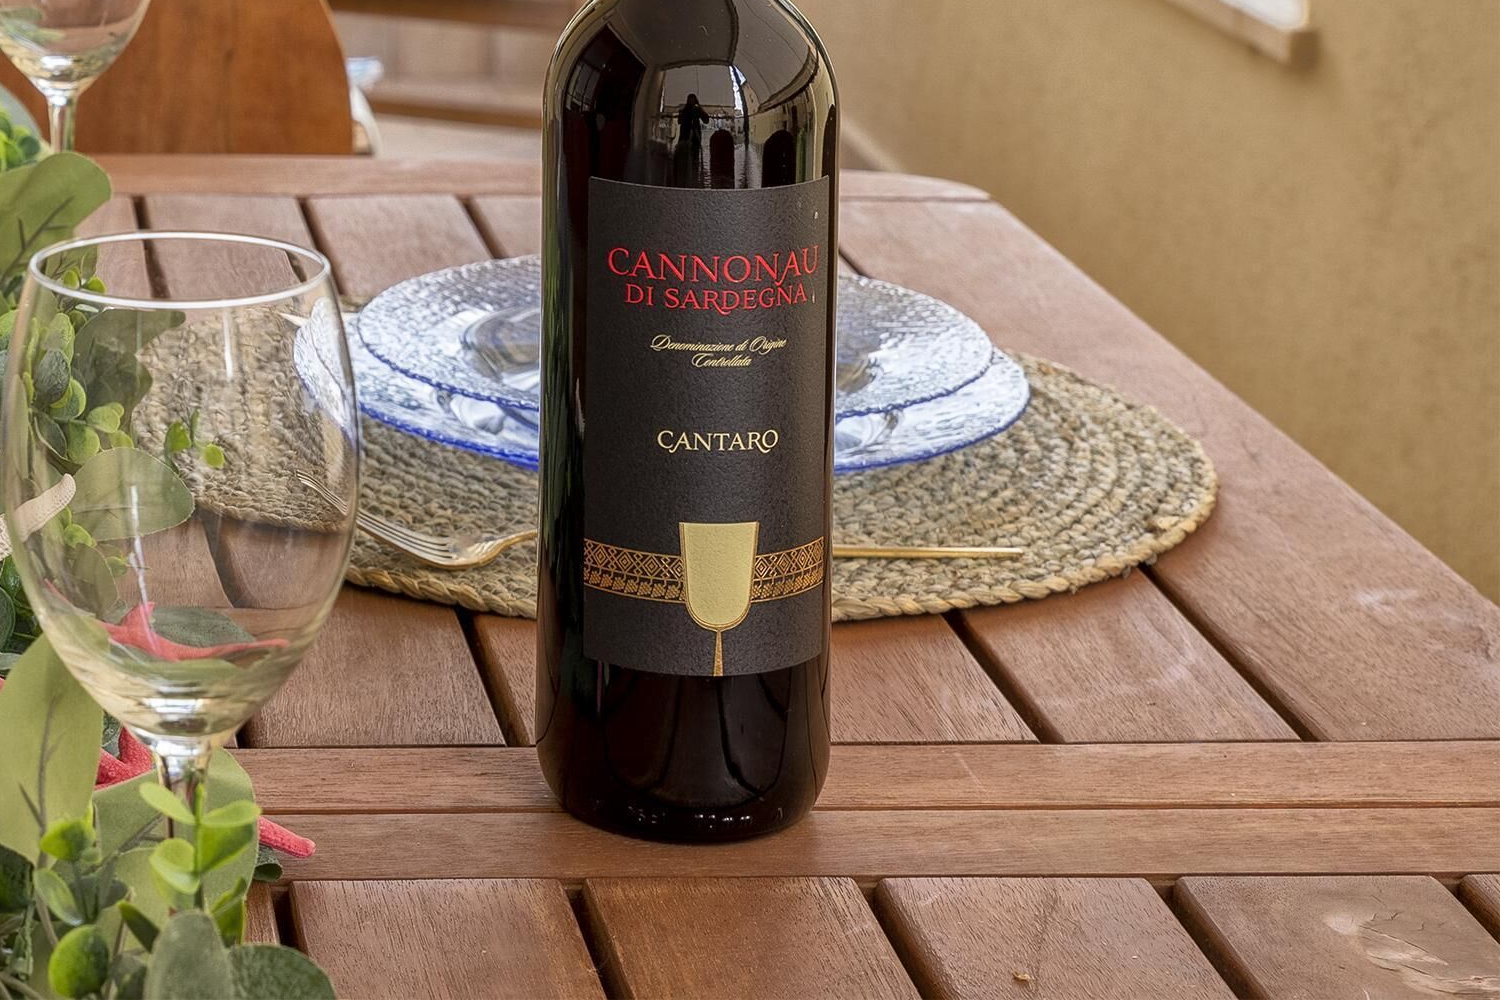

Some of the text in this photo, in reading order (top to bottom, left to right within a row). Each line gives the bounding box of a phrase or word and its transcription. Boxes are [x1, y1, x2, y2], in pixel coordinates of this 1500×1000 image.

[607, 245, 820, 287] CANNONAU
[625, 282, 808, 316] DI SARDEGNA
[651, 334, 787, 356] Denominazione di Origine
[692, 352, 752, 368] Controllata
[656, 428, 780, 455] CANTARO
